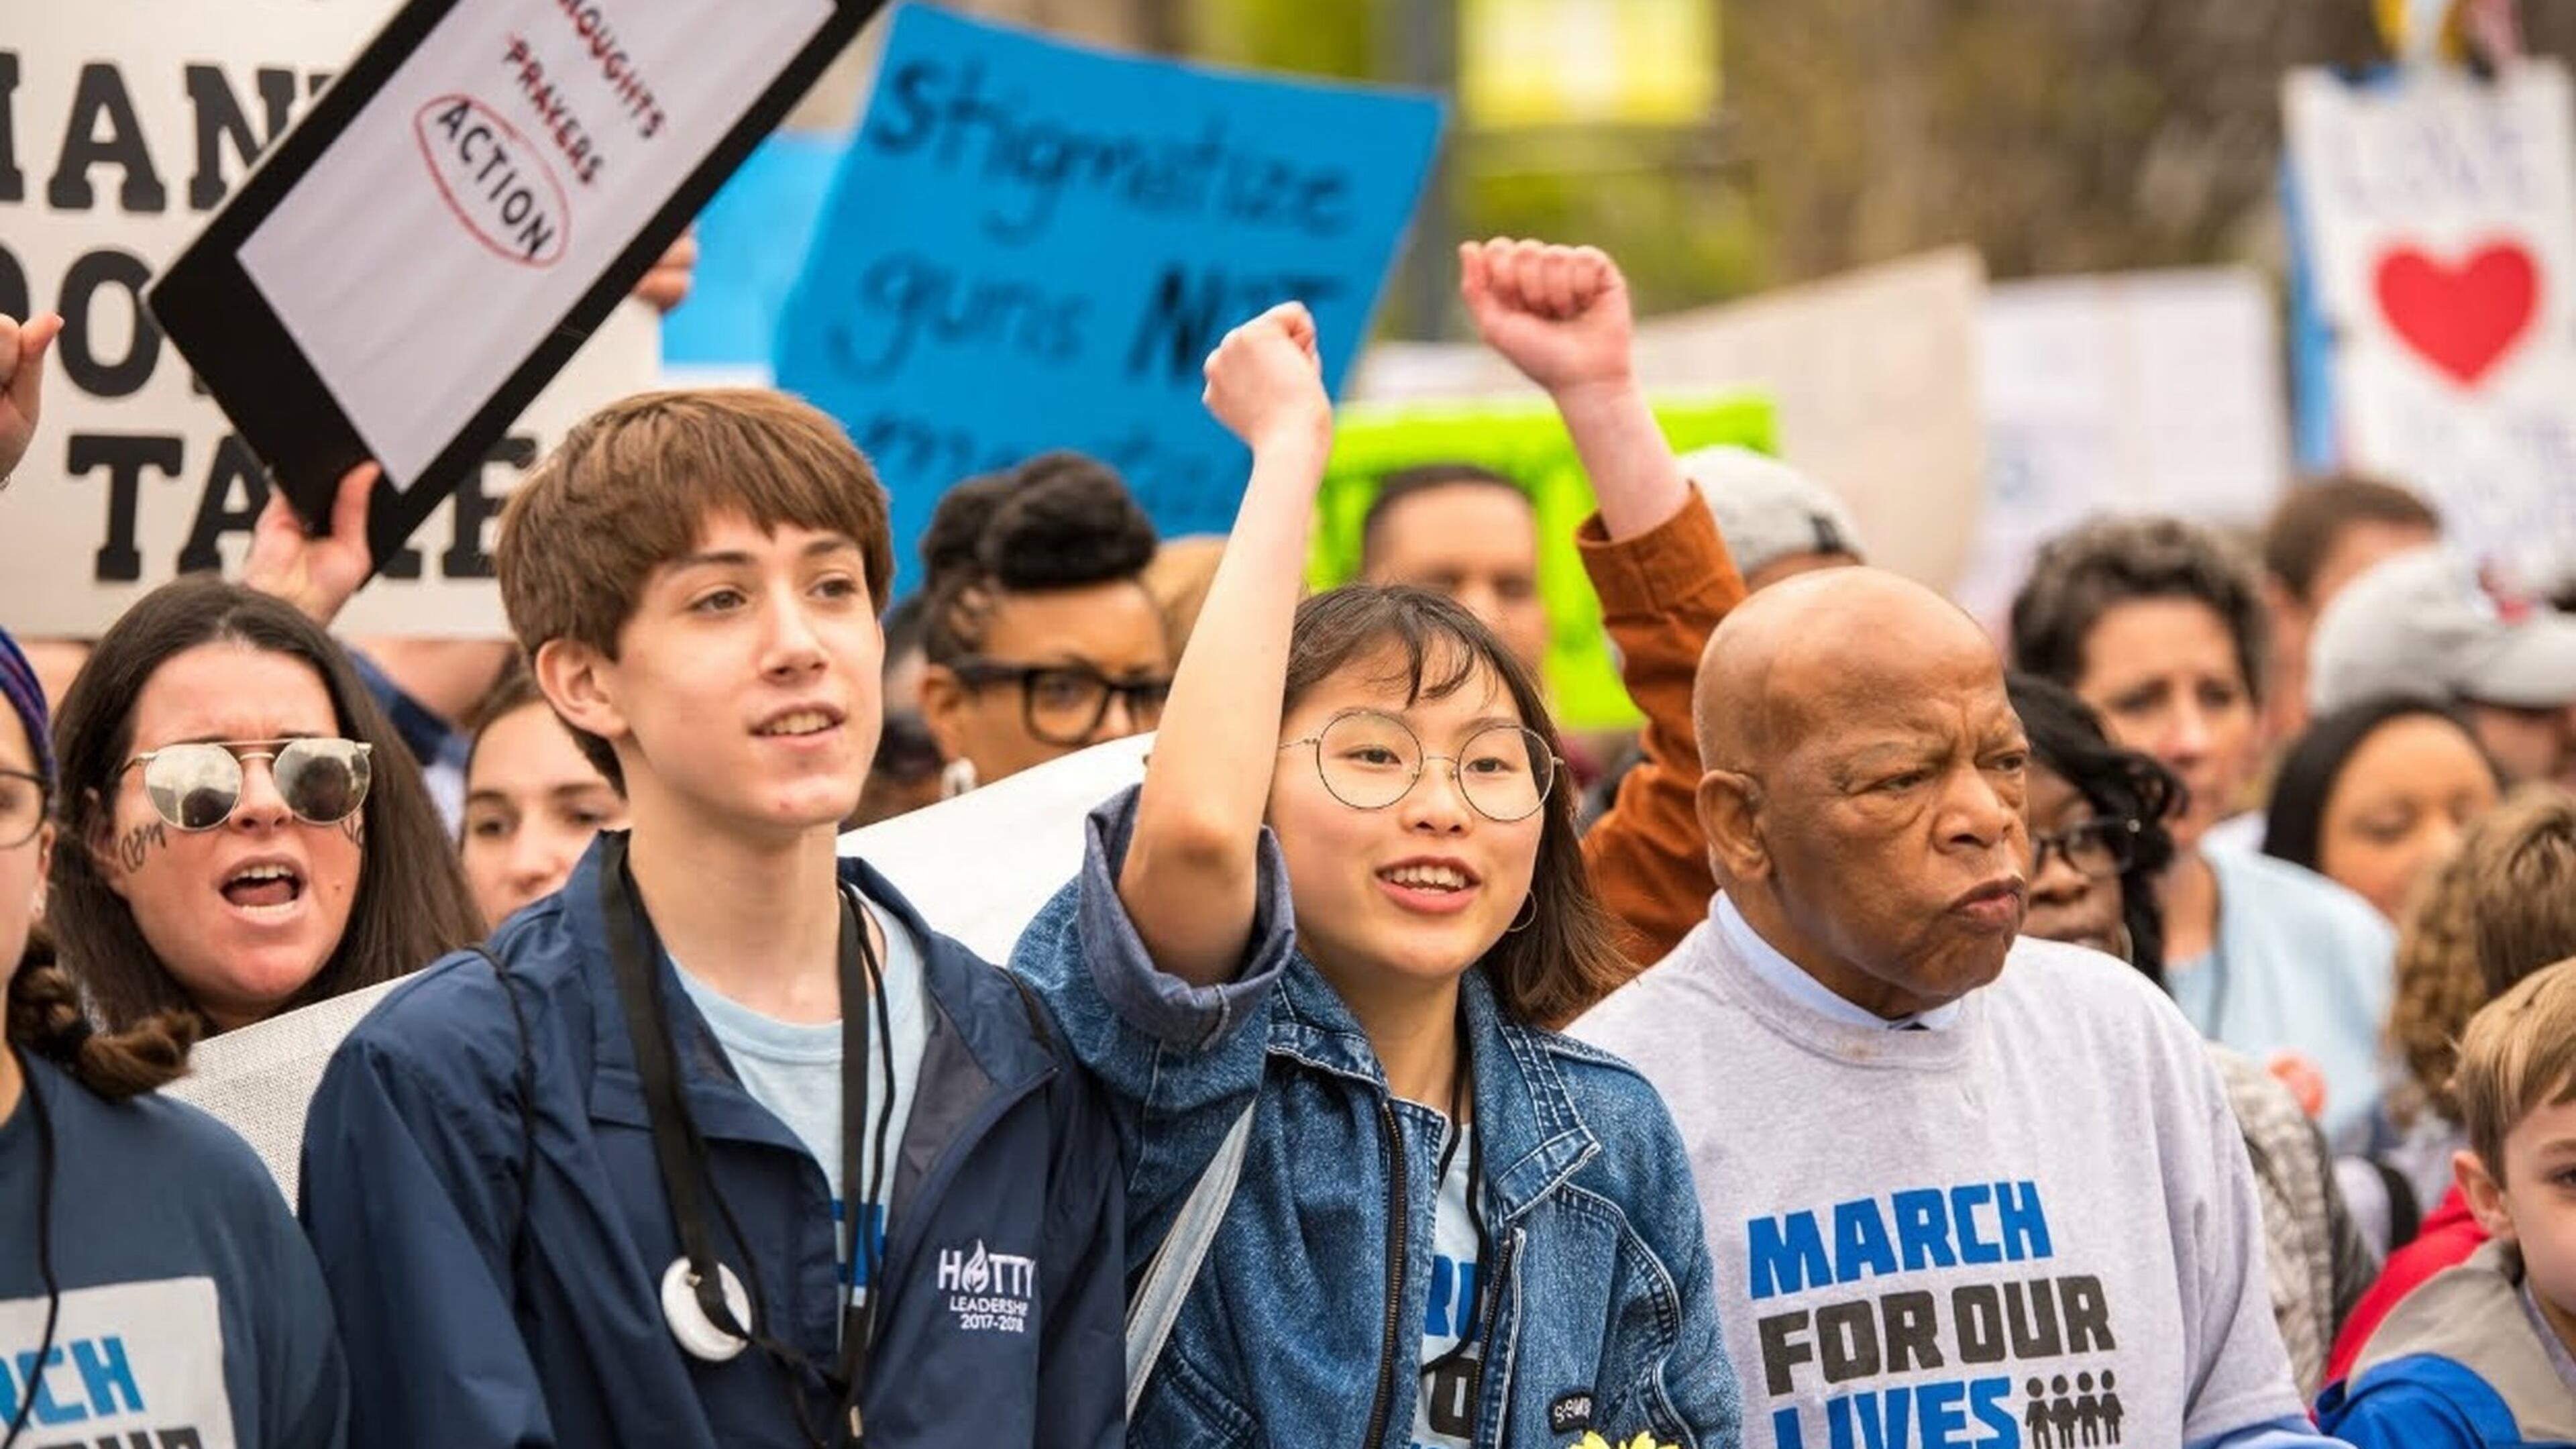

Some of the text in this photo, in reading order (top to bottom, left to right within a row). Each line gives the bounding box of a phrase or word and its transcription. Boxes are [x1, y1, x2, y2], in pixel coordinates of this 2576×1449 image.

[0, 51, 334, 213] AN
[437, 99, 554, 256] ACTION
[502, 39, 605, 184] PRAYERS
[1748, 1180, 2053, 1300] MARCH
[1758, 1275, 2116, 1397] FOR OUR
